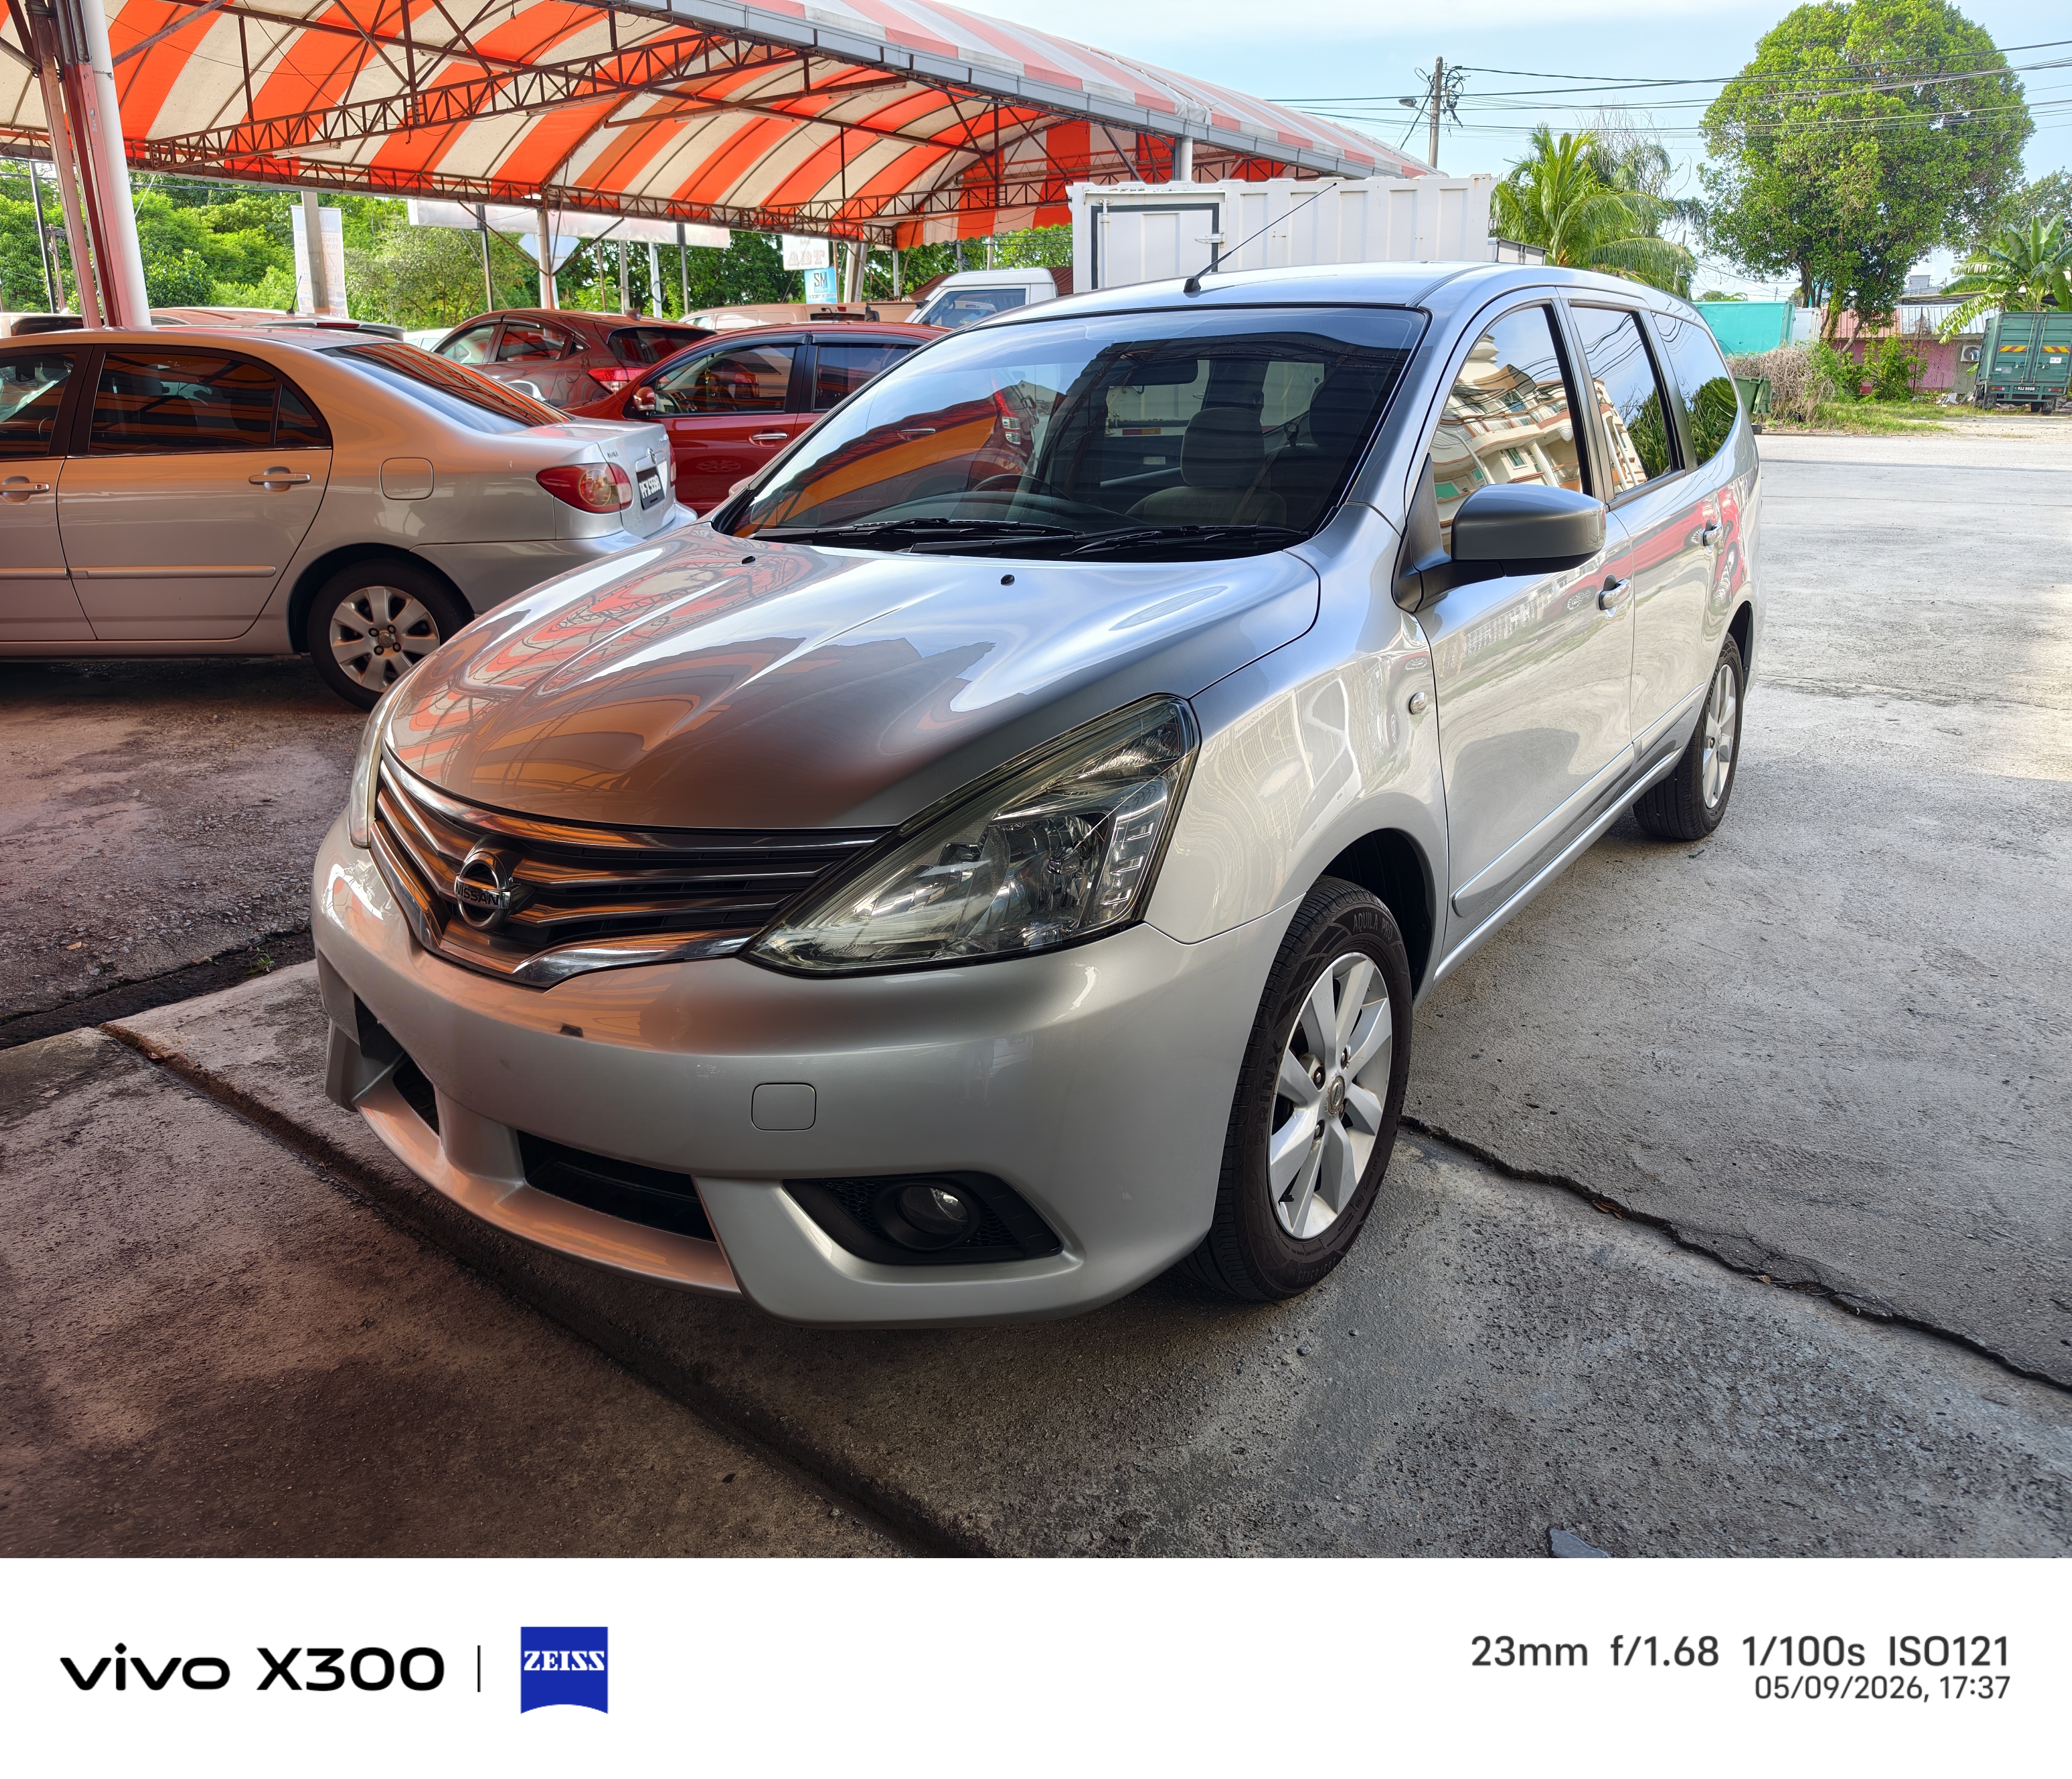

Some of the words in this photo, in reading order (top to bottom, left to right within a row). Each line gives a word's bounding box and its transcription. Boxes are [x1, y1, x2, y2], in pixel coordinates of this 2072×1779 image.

[787, 250, 825, 267] ABT
[814, 272, 828, 287] SM
[456, 883, 500, 906] NISSAN
[1353, 912, 1378, 933] AQUILA
[1381, 918, 1393, 941] PRO
[1253, 1039, 1283, 1148] PRINX
